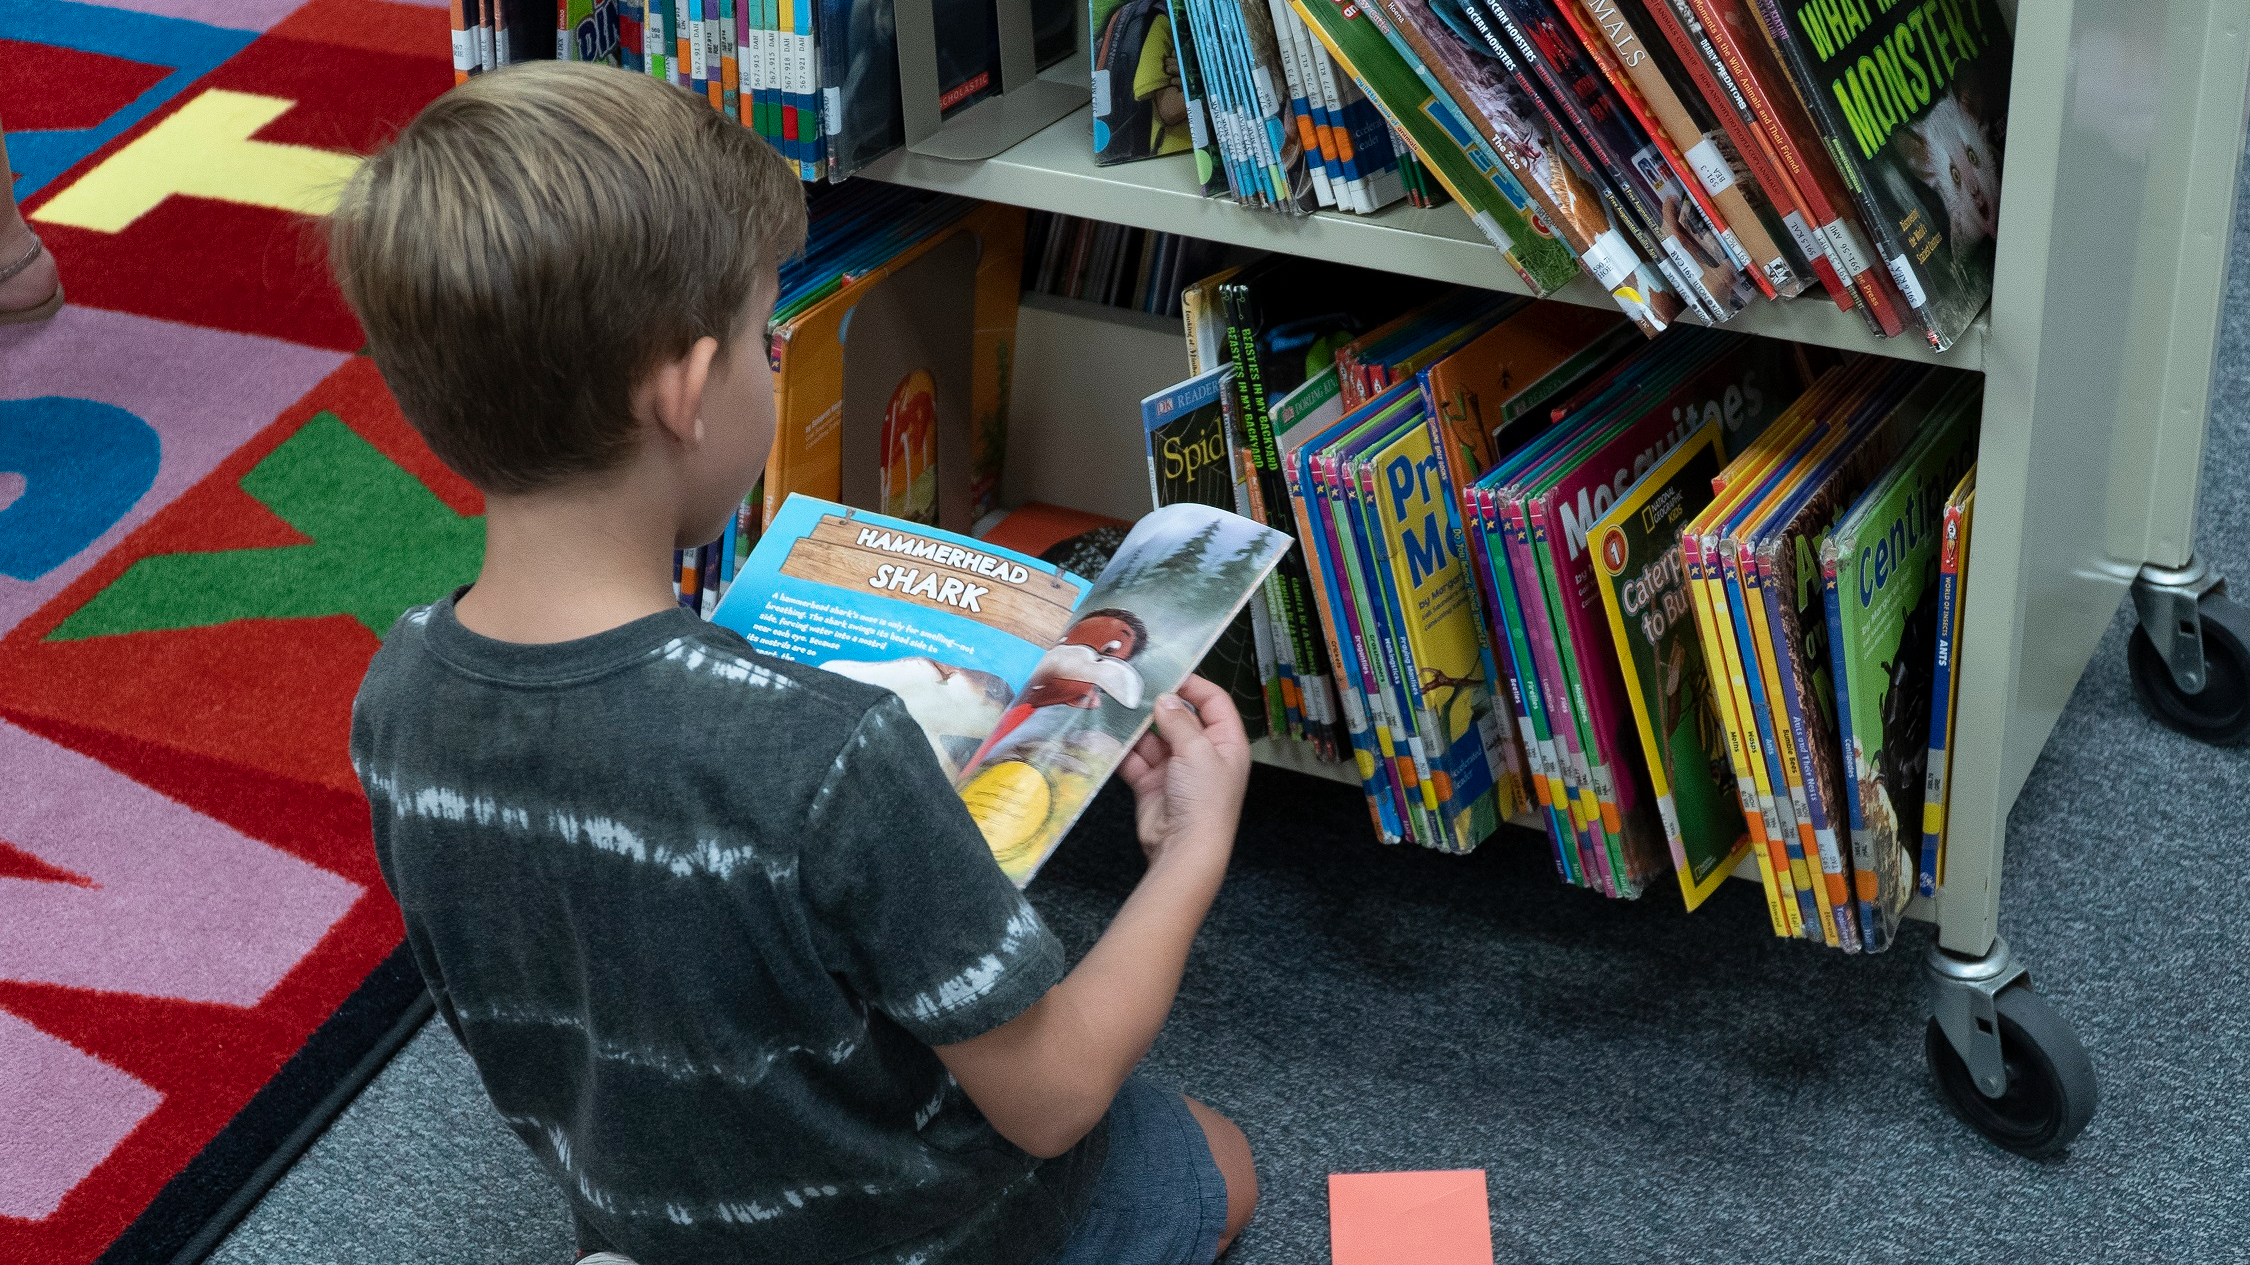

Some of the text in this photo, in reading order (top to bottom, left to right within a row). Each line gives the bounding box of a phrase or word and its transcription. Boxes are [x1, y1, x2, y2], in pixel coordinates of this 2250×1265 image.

[1388, 2, 1405, 24] Hoena
[1466, 6, 1517, 72] OCEAN MONSTERS
[1487, 0, 1538, 64] OCEAN MONSTERS
[1282, 50, 1291, 64] KLI
[1300, 53, 1309, 68] KLI
[1318, 61, 1327, 76] KLI
[1582, 40, 1601, 63] Animal
[1597, 61, 1617, 86] Clowns
[1694, 0, 1802, 175] Moments in the Wild: Animals and Their Friends
[1700, 38, 1747, 110] DEADLY PREDATORS
[1364, 85, 1378, 105] little
[1378, 102, 1392, 120] book
[1396, 126, 1419, 151] animals
[1492, 134, 1520, 170] The Zoo
[1700, 164, 1719, 188] 591.3
[1712, 167, 1726, 183] BEA
[1625, 189, 1656, 228] Free Augmented
[1608, 194, 1618, 206] Free
[1615, 206, 1638, 235] Augmented
[1647, 248, 1659, 260] App
[1790, 221, 1816, 257] 591.5 KAL
[1829, 224, 1842, 241] AMU
[1724, 232, 1750, 265] 591 McG
[1840, 242, 1860, 272] 591.56
[1670, 249, 1695, 280] 591 CAR
[1828, 251, 1849, 282] 591.53
[1666, 271, 1690, 301] 591 CAR
[1863, 284, 1880, 307] Press
[1894, 266, 1917, 304] 591.6 KEA
[1227, 326, 1264, 470] BEASTIES IN MY BACKYARD
[1241, 327, 1279, 472] BEASTIES IN MY BACKYARD
[1651, 486, 1675, 512] NATIONAL
[1654, 490, 1683, 524] GEOGRAPHIC
[1668, 504, 1683, 524] KIDS
[856, 527, 1029, 587] HAMMERHEAD
[1452, 527, 1468, 559] Do You
[1610, 542, 1620, 565] 1
[868, 562, 990, 614] SHARK
[779, 592, 830, 612] hammerhead
[829, 607, 859, 620] shark's
[887, 620, 909, 632] only
[906, 624, 919, 636] for
[1419, 597, 1430, 610] by
[1944, 600, 1950, 611] OF
[753, 623, 841, 651] near each eye. Because
[765, 602, 938, 653] breathing. The shark swings its head side to
[779, 616, 809, 632] forcing
[809, 626, 834, 637] water
[834, 631, 851, 641] into
[858, 636, 887, 651] nostril
[1641, 610, 1666, 646] to
[1942, 611, 1950, 637] INSECTS
[747, 632, 817, 658] its nostrils are so
[1331, 640, 1342, 668] Crickets
[1354, 634, 1370, 674] Dragonflies
[1400, 636, 1410, 665] Praying
[1938, 638, 1948, 667] ANTS
[1384, 638, 1400, 684] Walkingsticks
[1510, 678, 1521, 704] Beetles
[1526, 680, 1539, 710] Fireflies
[1730, 730, 1740, 753] Moths
[1747, 730, 1758, 754] Wasps
[1764, 738, 1774, 756] Ants
[1782, 729, 1794, 755] Bumble
[1798, 734, 1806, 753] and
[1801, 752, 1812, 775] Their
[1844, 738, 1855, 779] Centipedes
[1808, 776, 1818, 802] Nests
